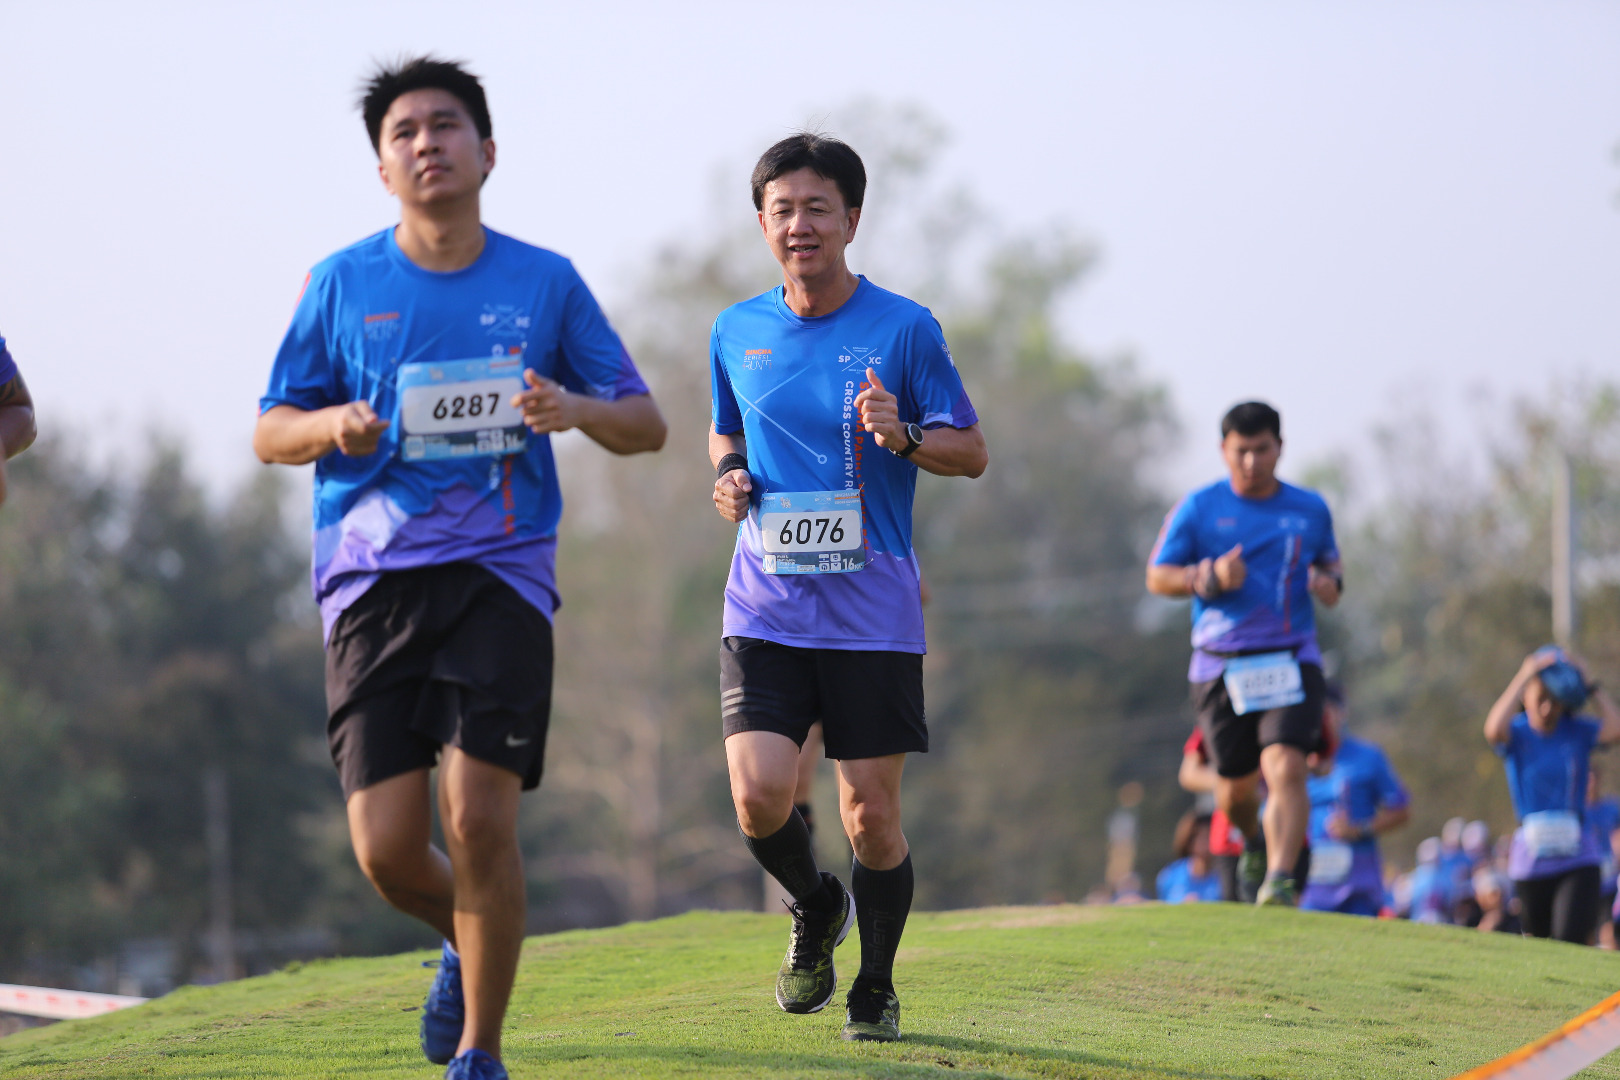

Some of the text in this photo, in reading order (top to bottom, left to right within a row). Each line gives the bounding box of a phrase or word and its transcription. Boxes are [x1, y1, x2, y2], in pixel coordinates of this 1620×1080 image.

[838, 355, 882, 365] SP XC
[432, 392, 501, 420] 6287
[843, 380, 855, 420] CROSS
[842, 422, 854, 478] COUNTRY
[779, 517, 845, 545] 6076
[842, 557, 854, 571] 16
